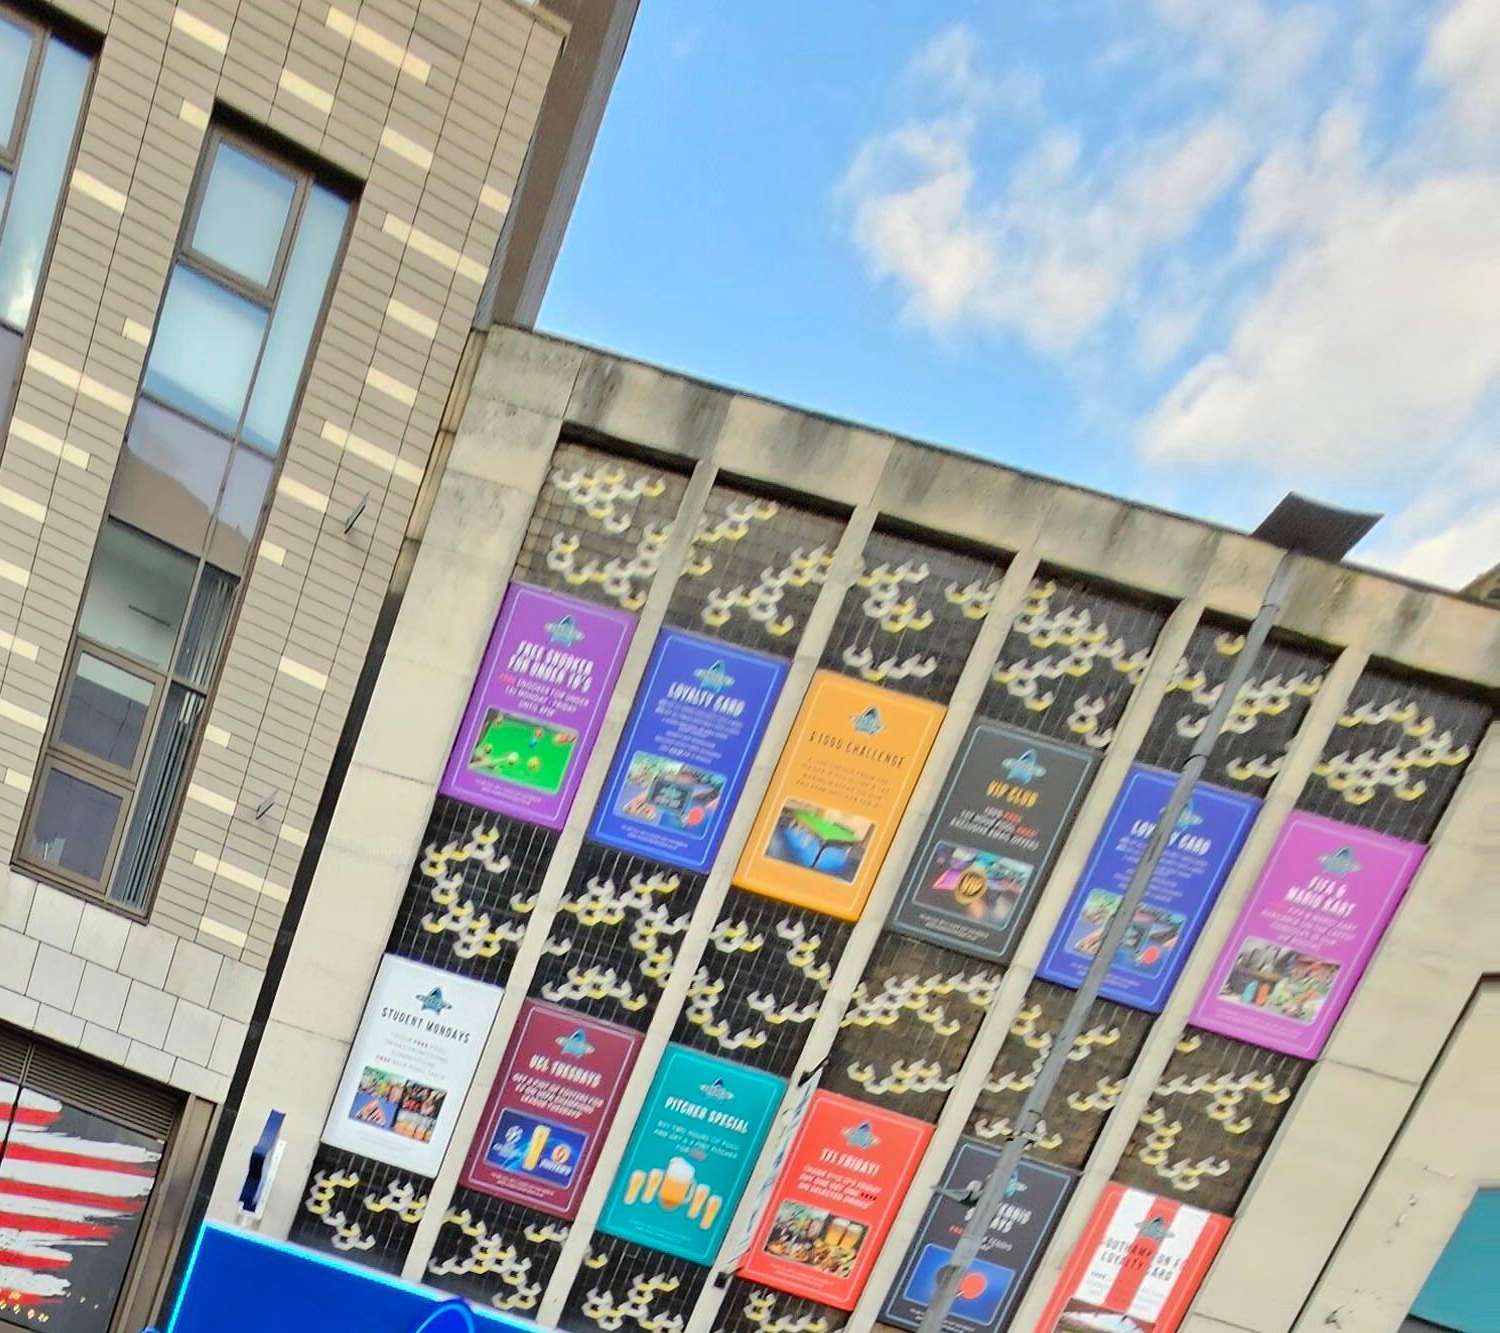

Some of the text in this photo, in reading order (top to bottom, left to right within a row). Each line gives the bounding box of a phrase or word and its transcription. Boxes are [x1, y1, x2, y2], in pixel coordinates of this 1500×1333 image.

[506, 653, 531, 675] FOR
[527, 660, 567, 685] UNDER
[514, 640, 595, 676] FREE SNOOKER
[666, 680, 747, 718] LOYALTY CARD
[844, 741, 905, 768] CHALLENGE
[983, 779, 1040, 809] VIP CLUB
[1128, 819, 1213, 857] LOYY CARD
[1283, 885, 1326, 909] MARIO
[1319, 895, 1357, 919] KART
[1305, 875, 1338, 896] FIFA
[379, 1006, 472, 1044] STUDENT MONDAYS
[527, 1053, 603, 1089] UCL TUESDAYS
[662, 1095, 752, 1135] PITCHER SPECIAL
